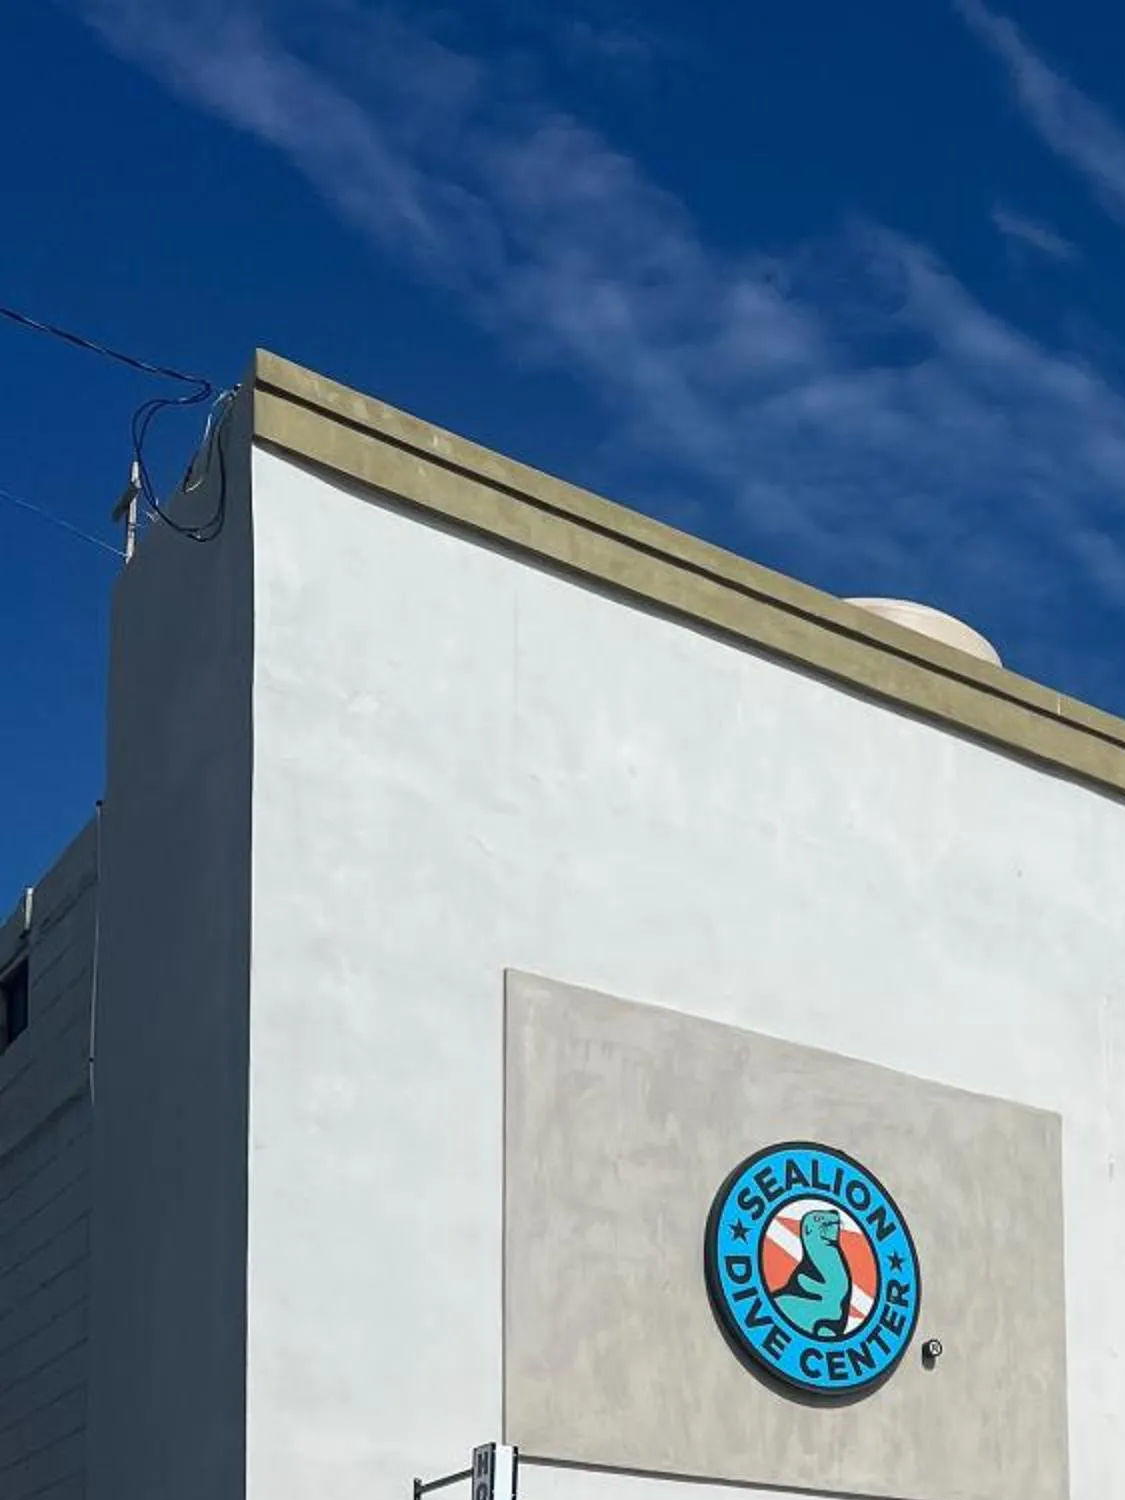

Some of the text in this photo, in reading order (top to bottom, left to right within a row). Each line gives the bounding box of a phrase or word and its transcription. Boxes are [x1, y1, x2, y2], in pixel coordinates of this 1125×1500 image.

[737, 1159, 896, 1242] SEALION
[725, 1255, 910, 1381] DIVE CENTER
